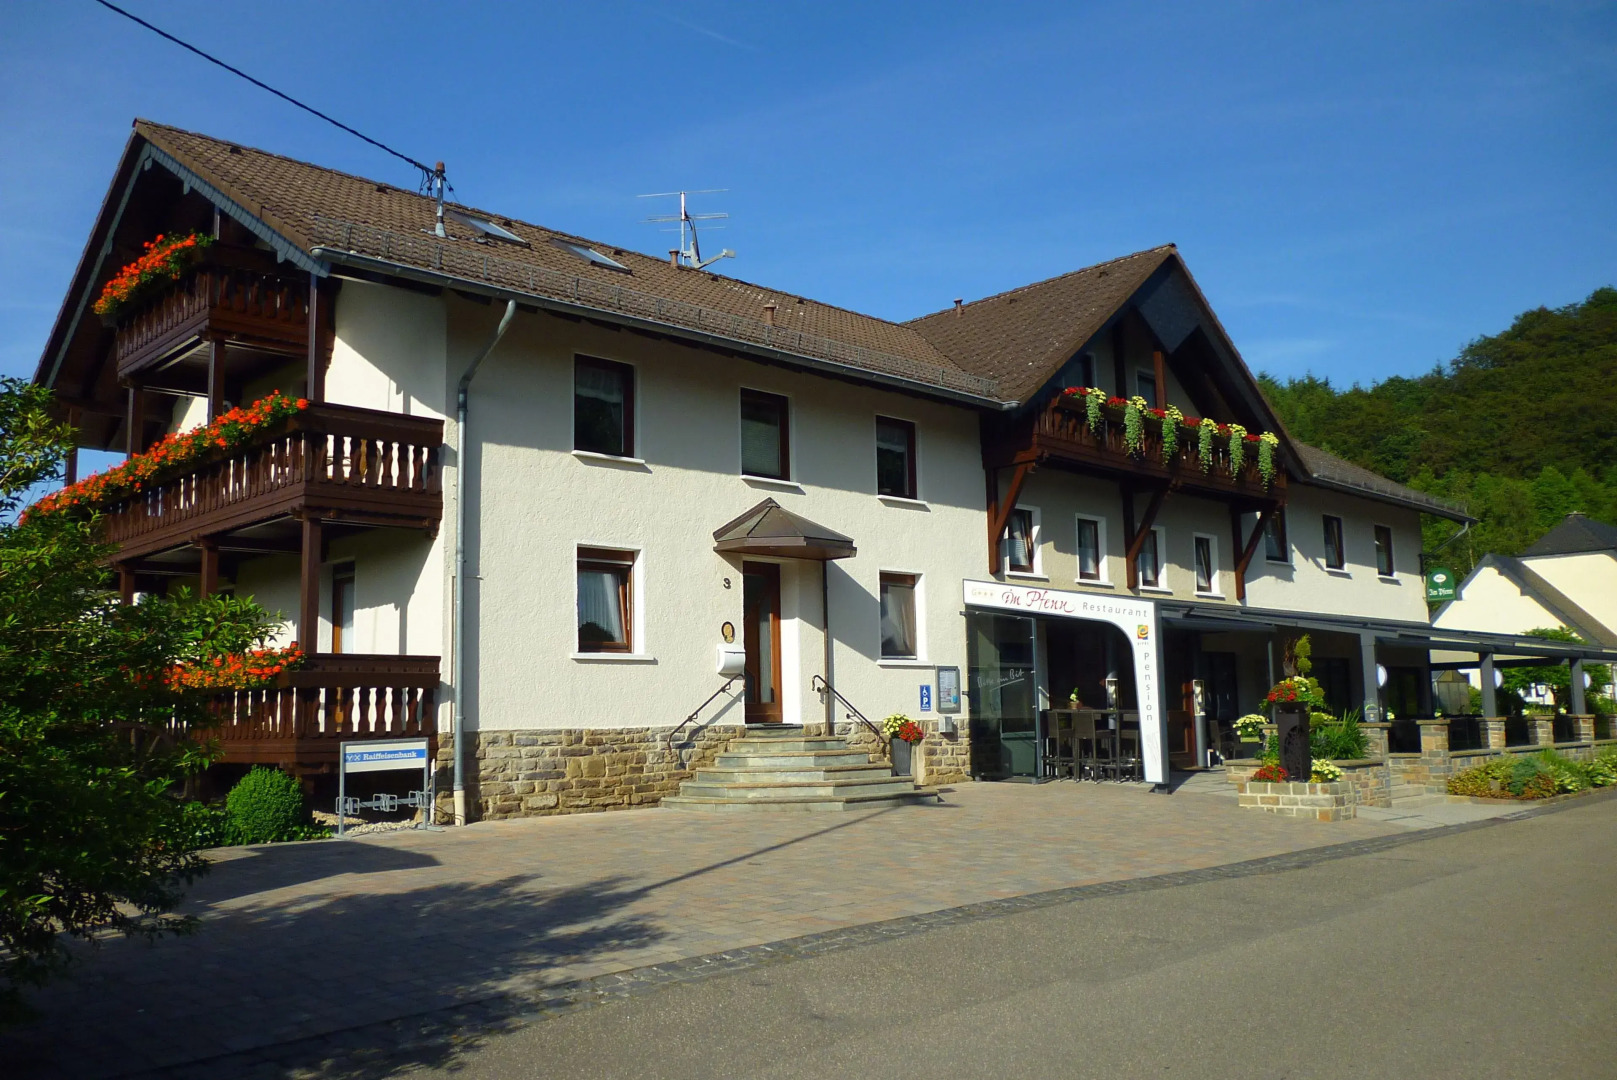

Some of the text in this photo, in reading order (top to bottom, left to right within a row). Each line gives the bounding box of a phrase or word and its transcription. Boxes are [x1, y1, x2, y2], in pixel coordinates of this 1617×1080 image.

[723, 577, 731, 589] 3
[1026, 590, 1075, 613] Pfenn
[1082, 601, 1148, 618] Restaurant
[1144, 652, 1153, 721] Pension
[923, 697, 929, 705] P
[363, 750, 417, 761] Raiffeisenbank
